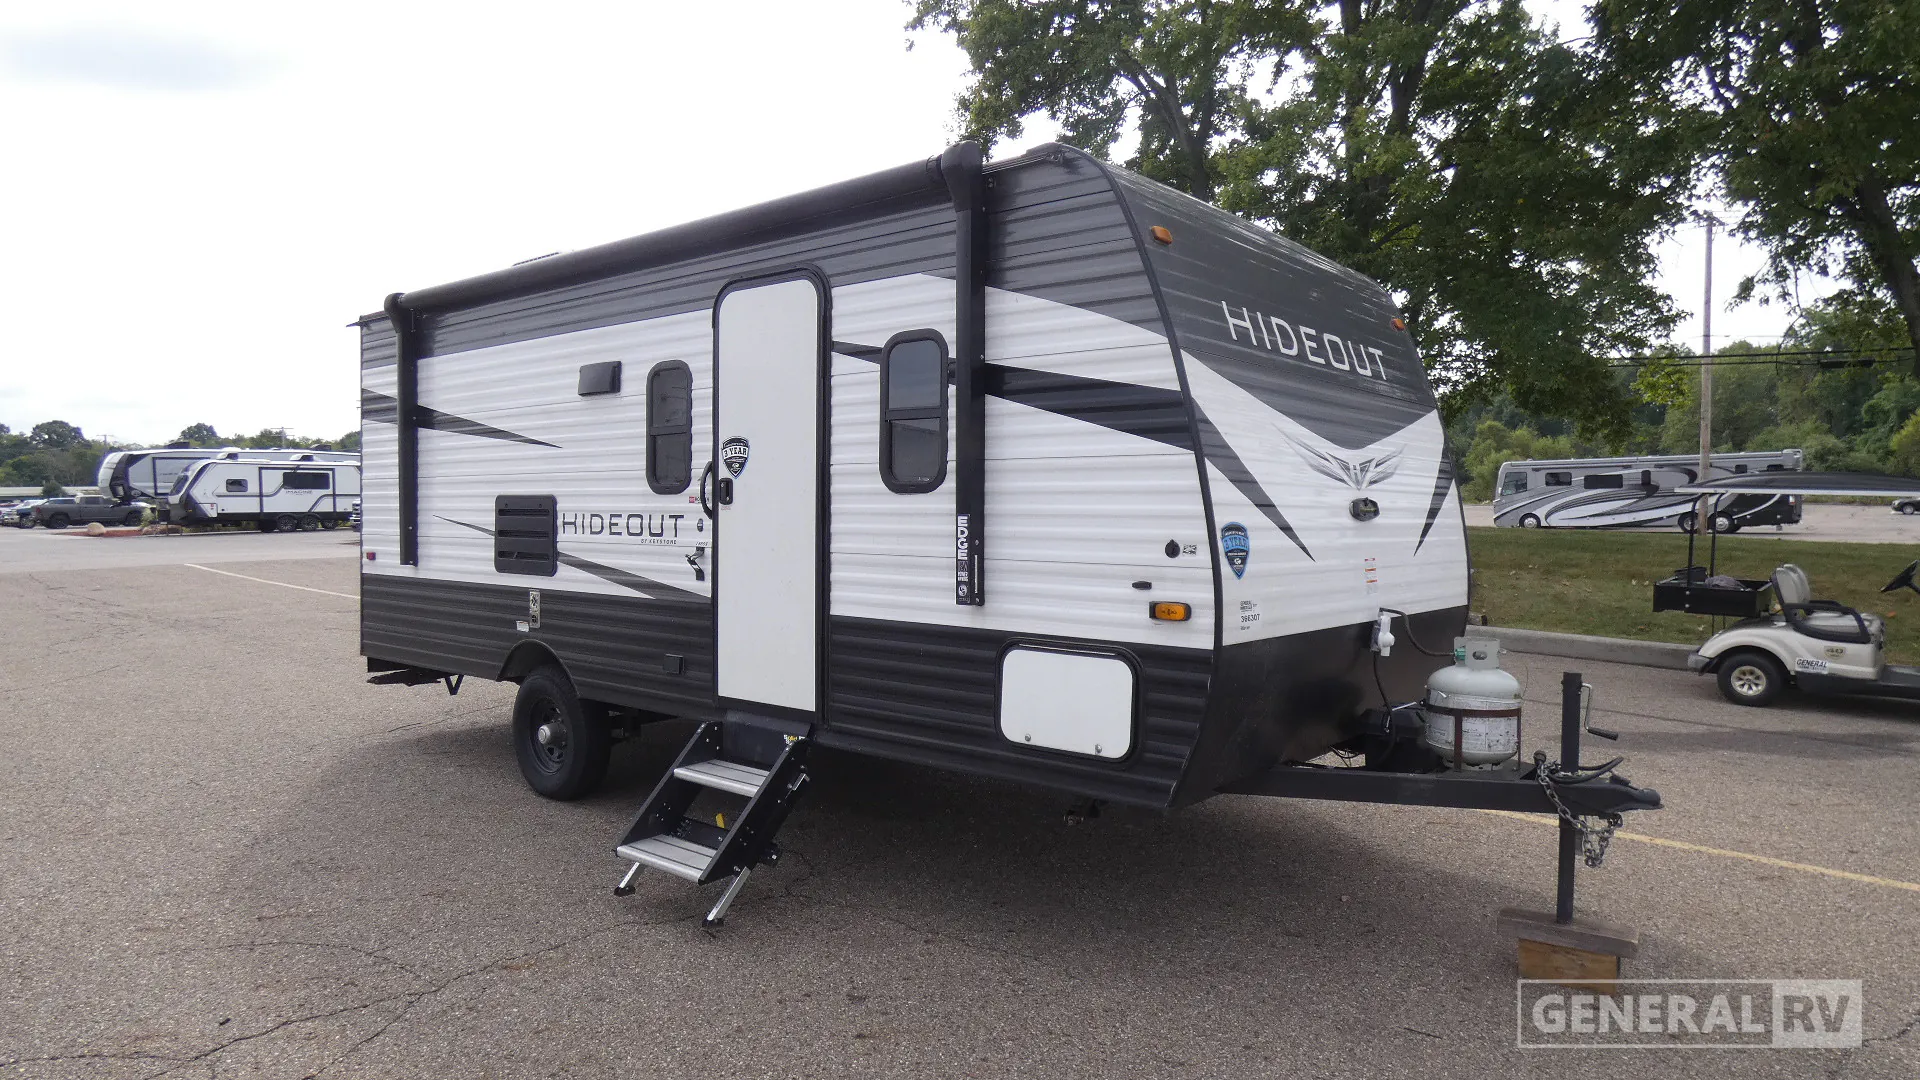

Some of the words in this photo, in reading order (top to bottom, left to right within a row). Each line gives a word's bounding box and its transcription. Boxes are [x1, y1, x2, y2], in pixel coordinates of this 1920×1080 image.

[1221, 300, 1387, 380] HIDEOUT
[729, 447, 747, 456] YEAR
[562, 513, 684, 538] HIDEOUT
[957, 516, 968, 560] EDGE
[1796, 658, 1828, 668] GENERAL
